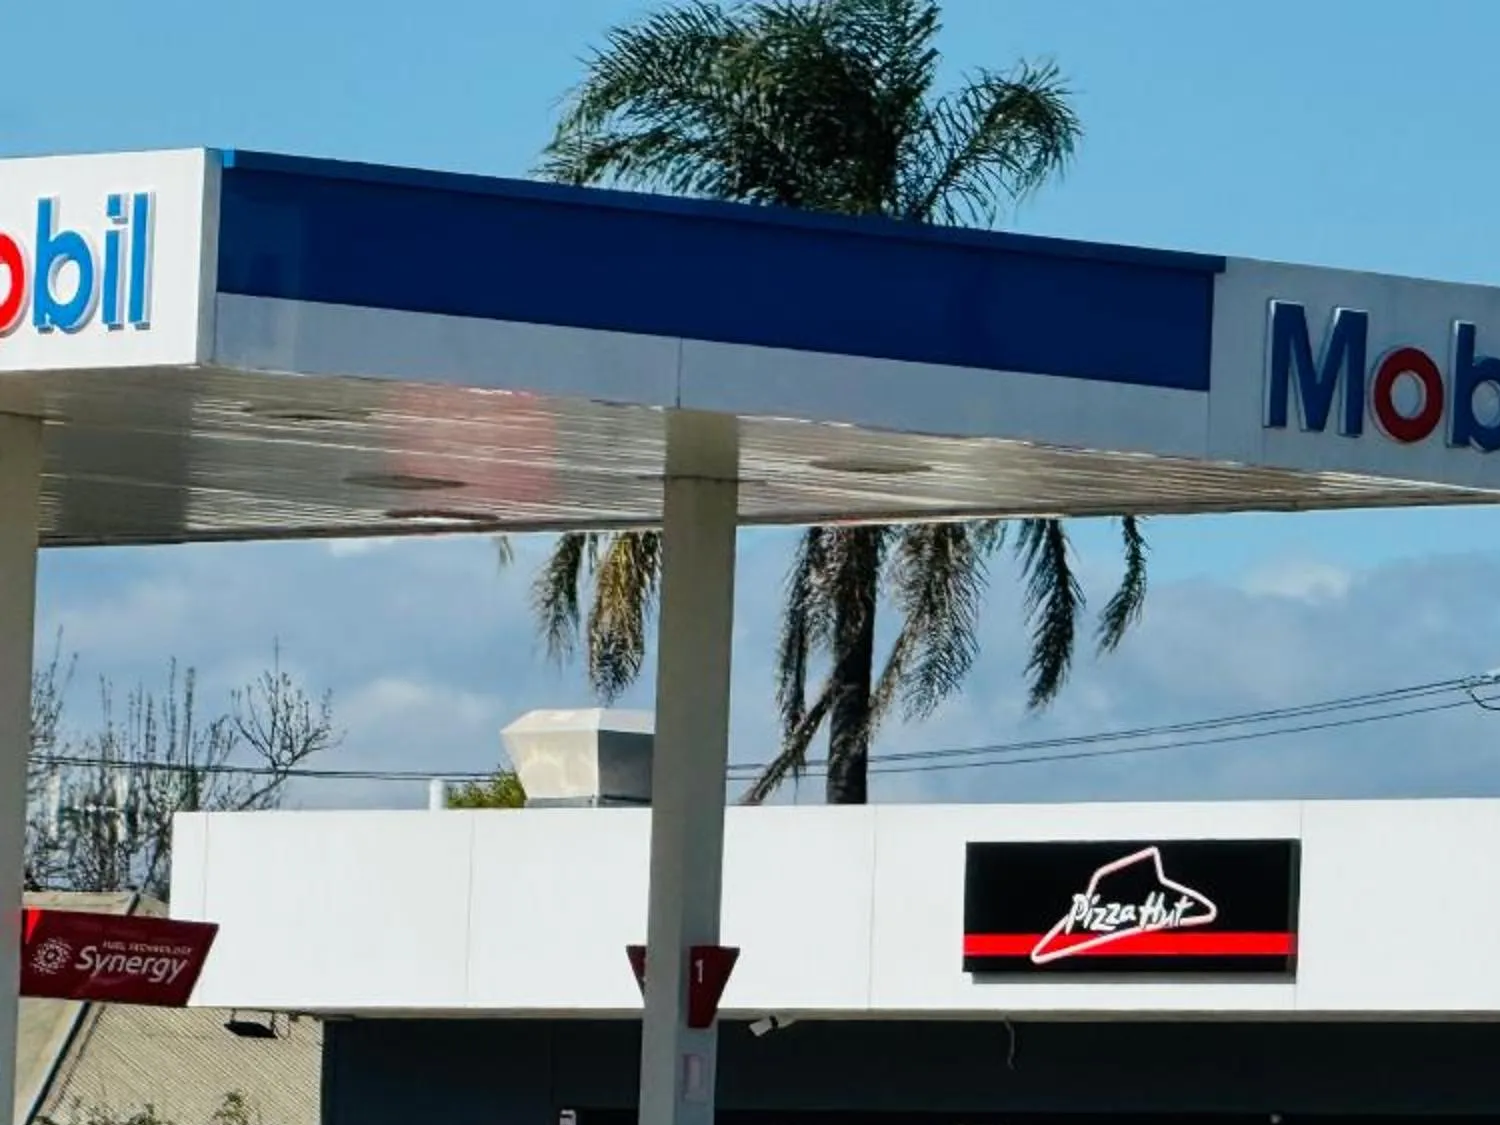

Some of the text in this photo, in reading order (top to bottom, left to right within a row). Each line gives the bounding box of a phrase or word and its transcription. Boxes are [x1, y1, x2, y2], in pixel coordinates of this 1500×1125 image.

[1066, 891, 1196, 934] Pizza Hut
[75, 945, 188, 985] Synergy
[694, 959, 703, 984] 1
